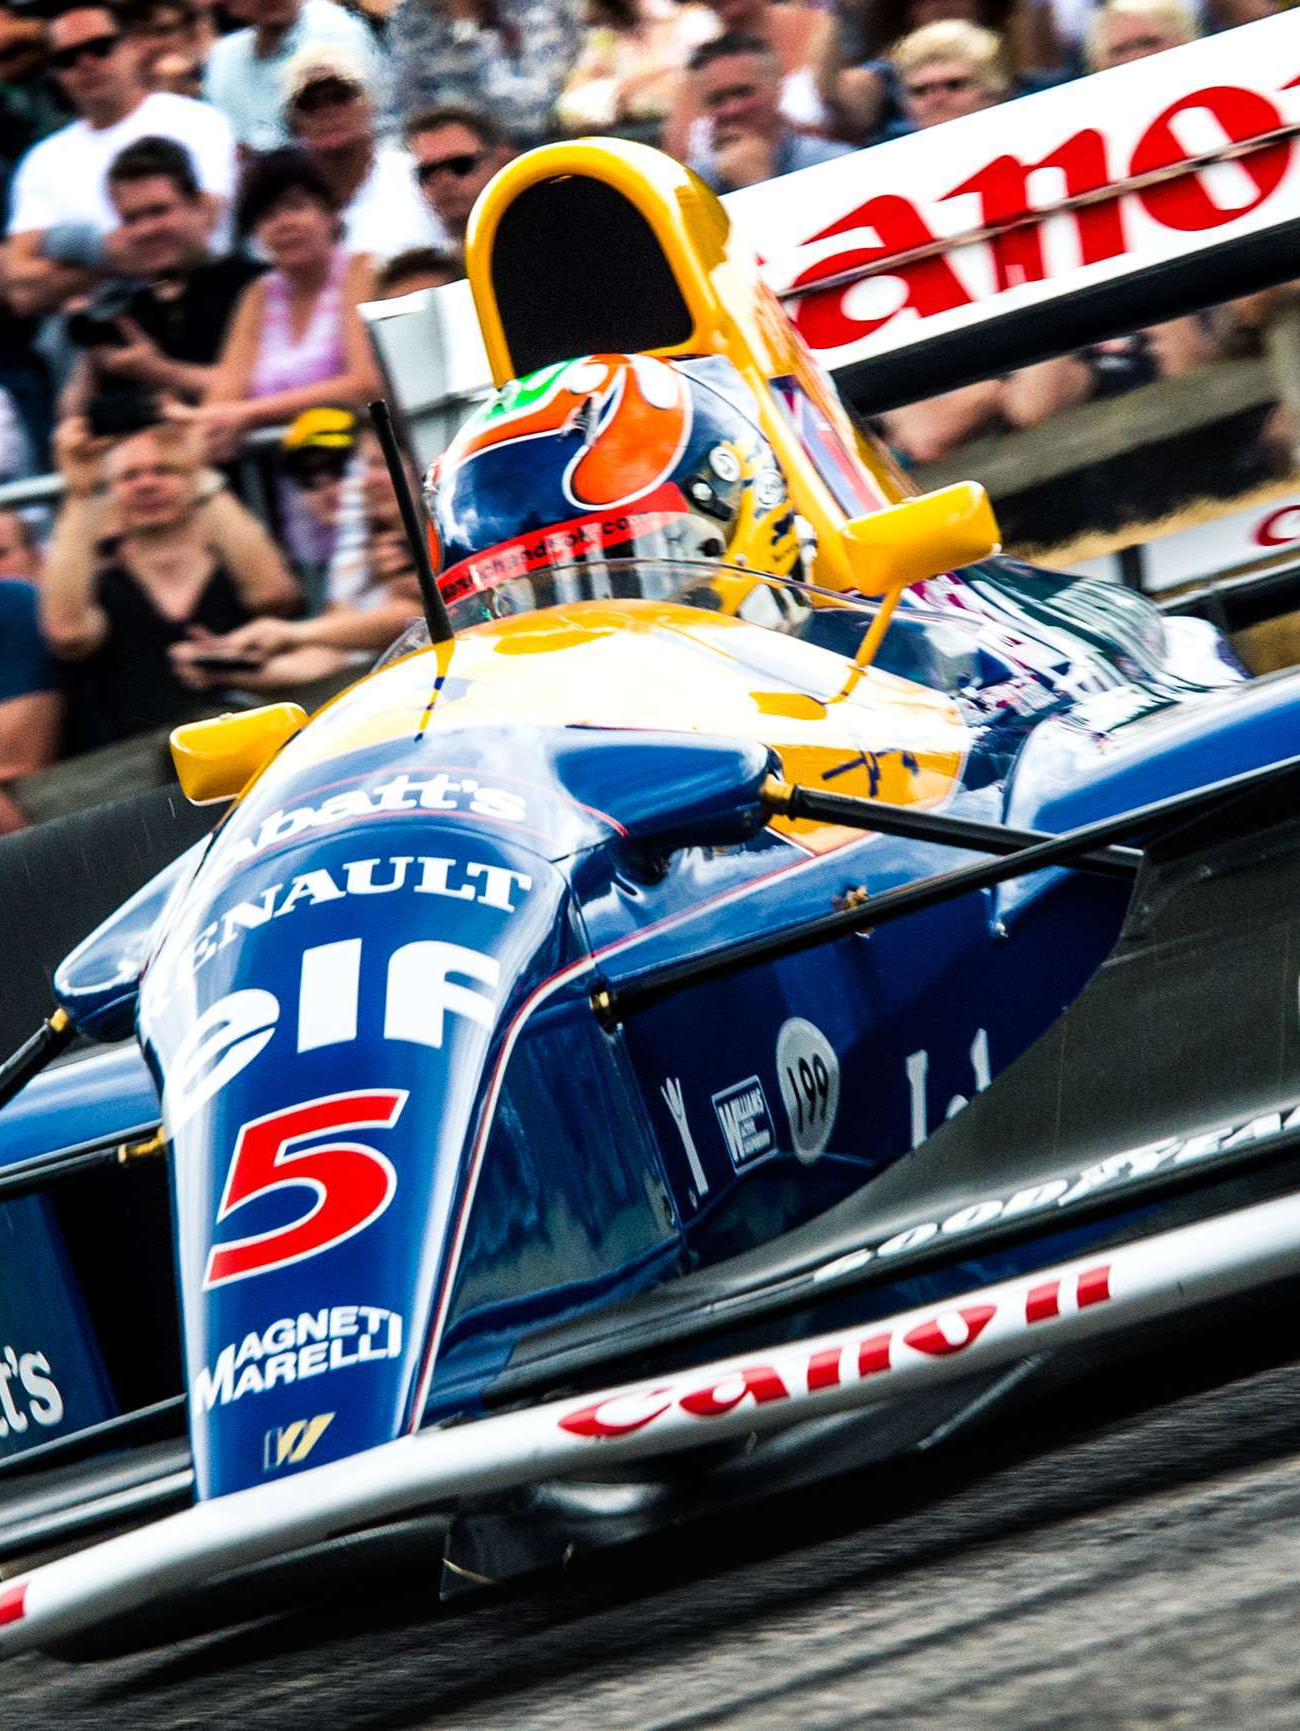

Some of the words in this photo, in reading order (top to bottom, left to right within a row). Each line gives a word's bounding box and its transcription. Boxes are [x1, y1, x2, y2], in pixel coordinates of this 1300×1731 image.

[792, 75, 1300, 349] ano
[192, 856, 532, 971] ENAULT
[170, 938, 500, 1135] elf
[201, 1088, 410, 1292] 5
[813, 1102, 1300, 1282] GOODYEA
[194, 1306, 402, 1408] MAGNETI
[194, 1332, 402, 1418] MARELLI
